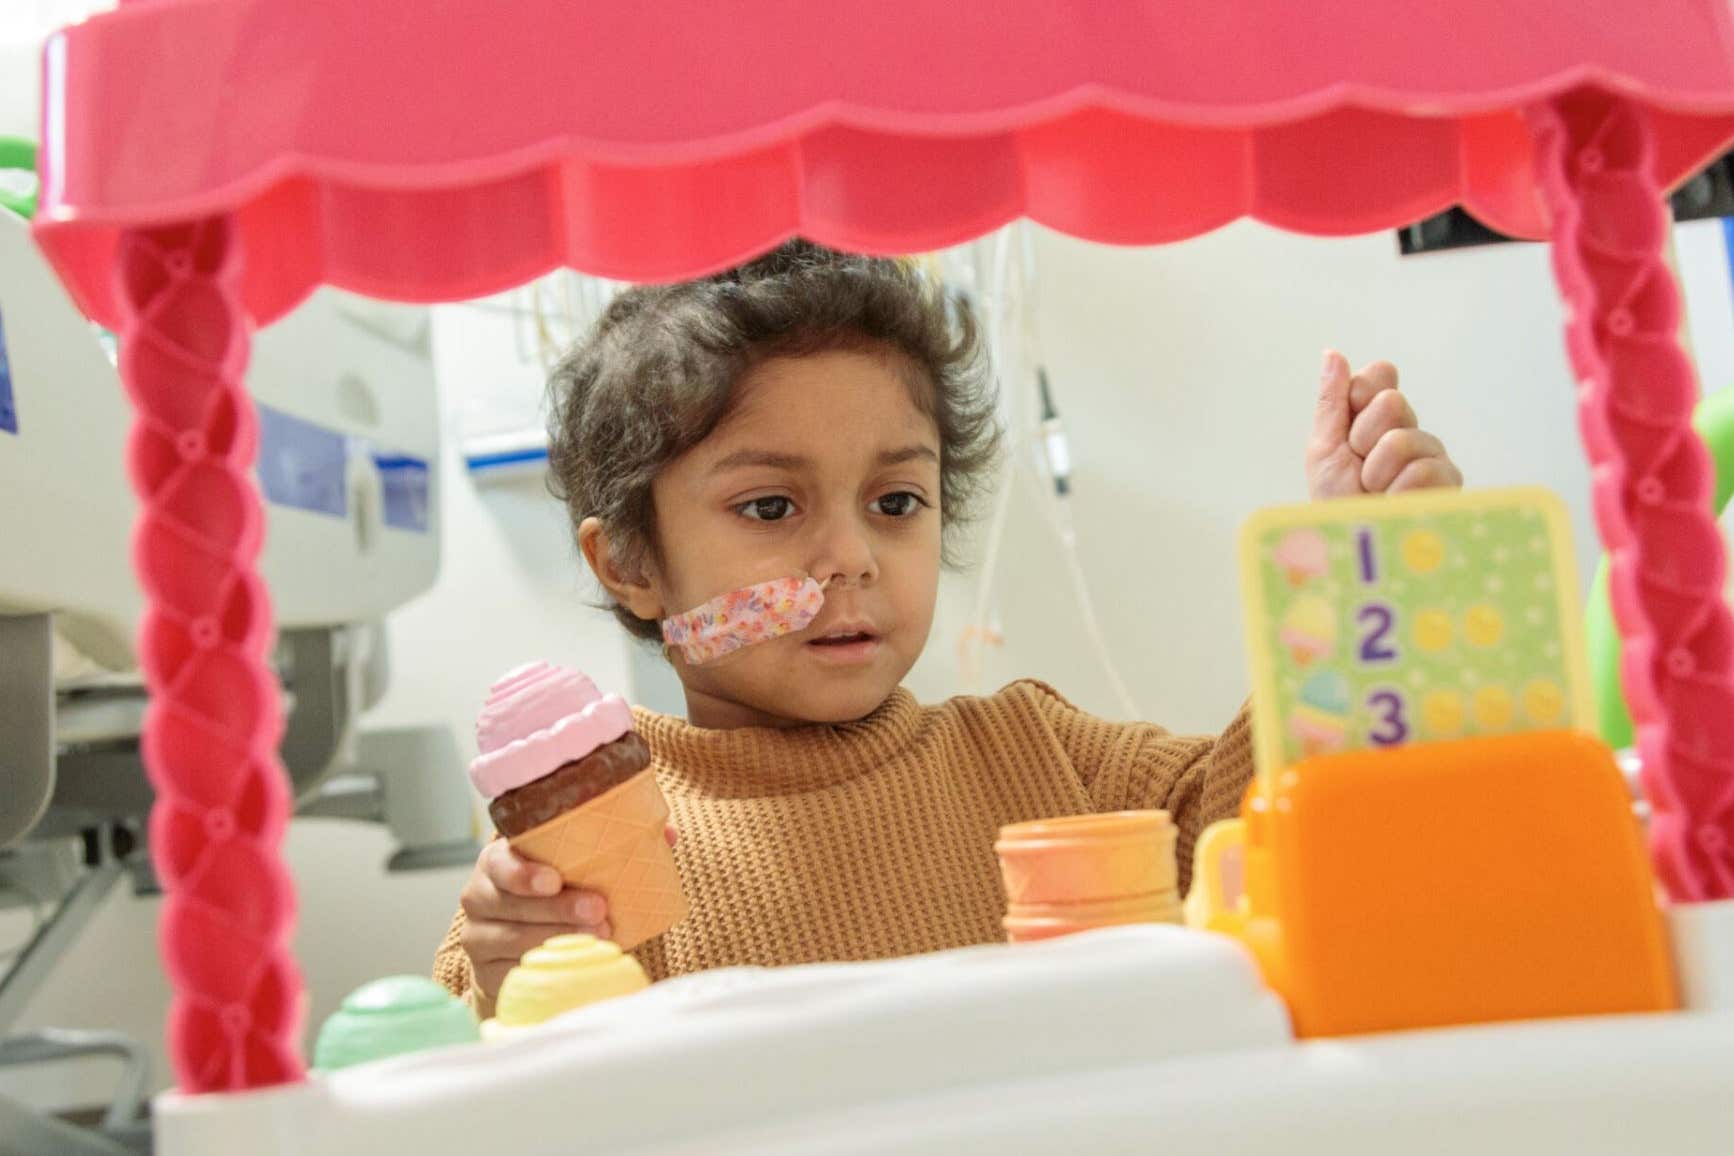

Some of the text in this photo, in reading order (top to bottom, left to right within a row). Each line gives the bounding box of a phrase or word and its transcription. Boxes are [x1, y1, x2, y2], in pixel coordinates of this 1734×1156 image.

[1357, 528, 1376, 584] 1
[1356, 604, 1397, 662] 2
[1367, 691, 1409, 747] 3
